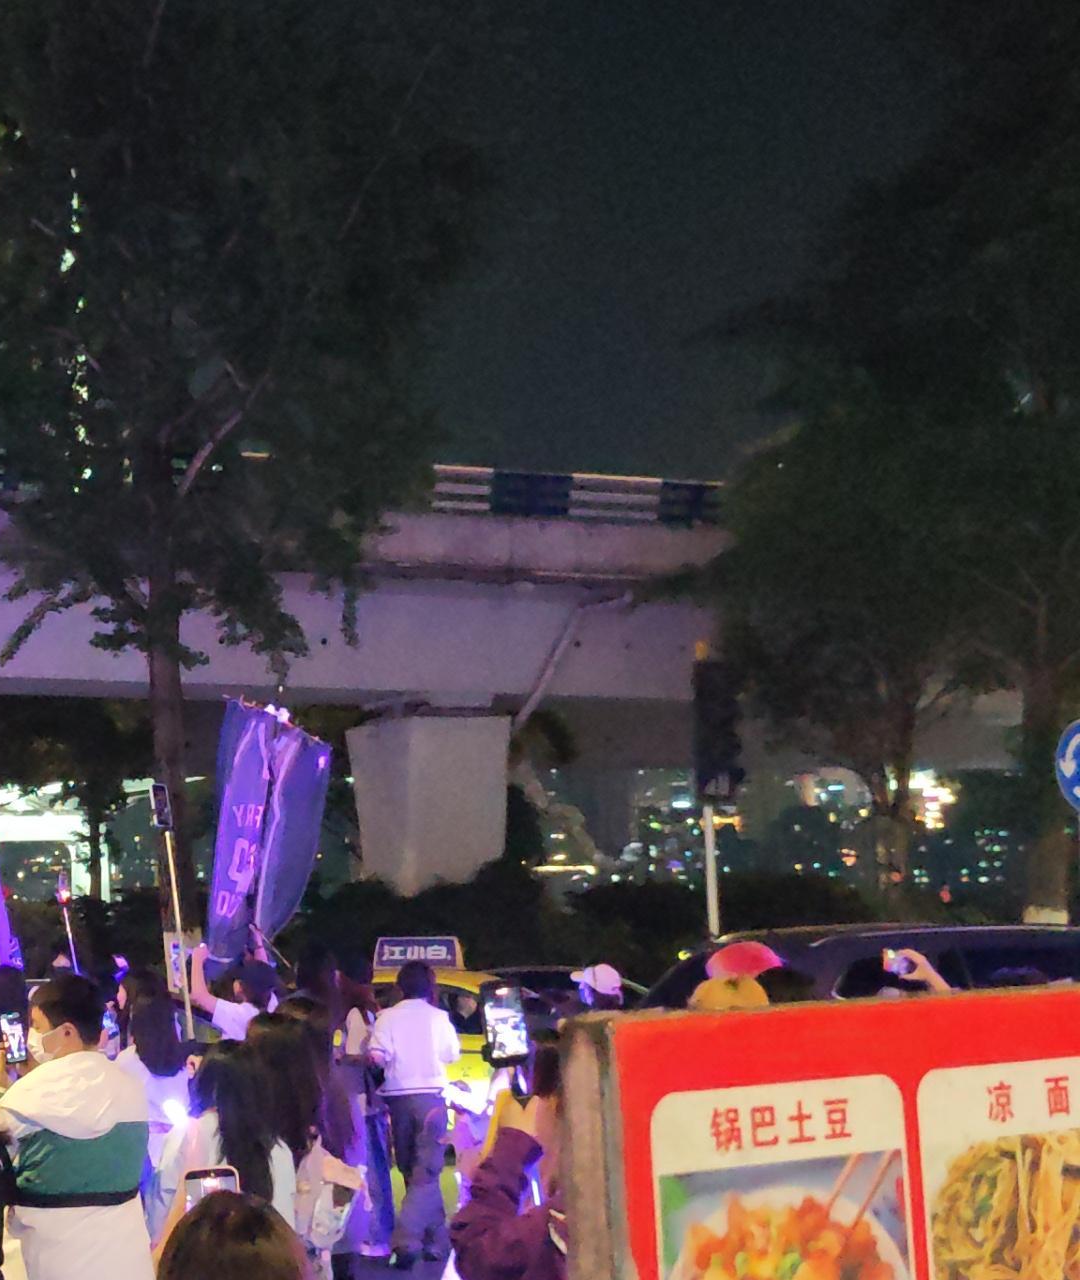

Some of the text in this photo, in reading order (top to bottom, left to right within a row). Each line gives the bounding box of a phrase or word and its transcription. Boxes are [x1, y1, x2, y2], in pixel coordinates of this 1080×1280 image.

[382, 944, 450, 961] 江小白
[986, 1076, 1071, 1123] 凉面
[710, 1098, 852, 1152] 锅巴土豆
